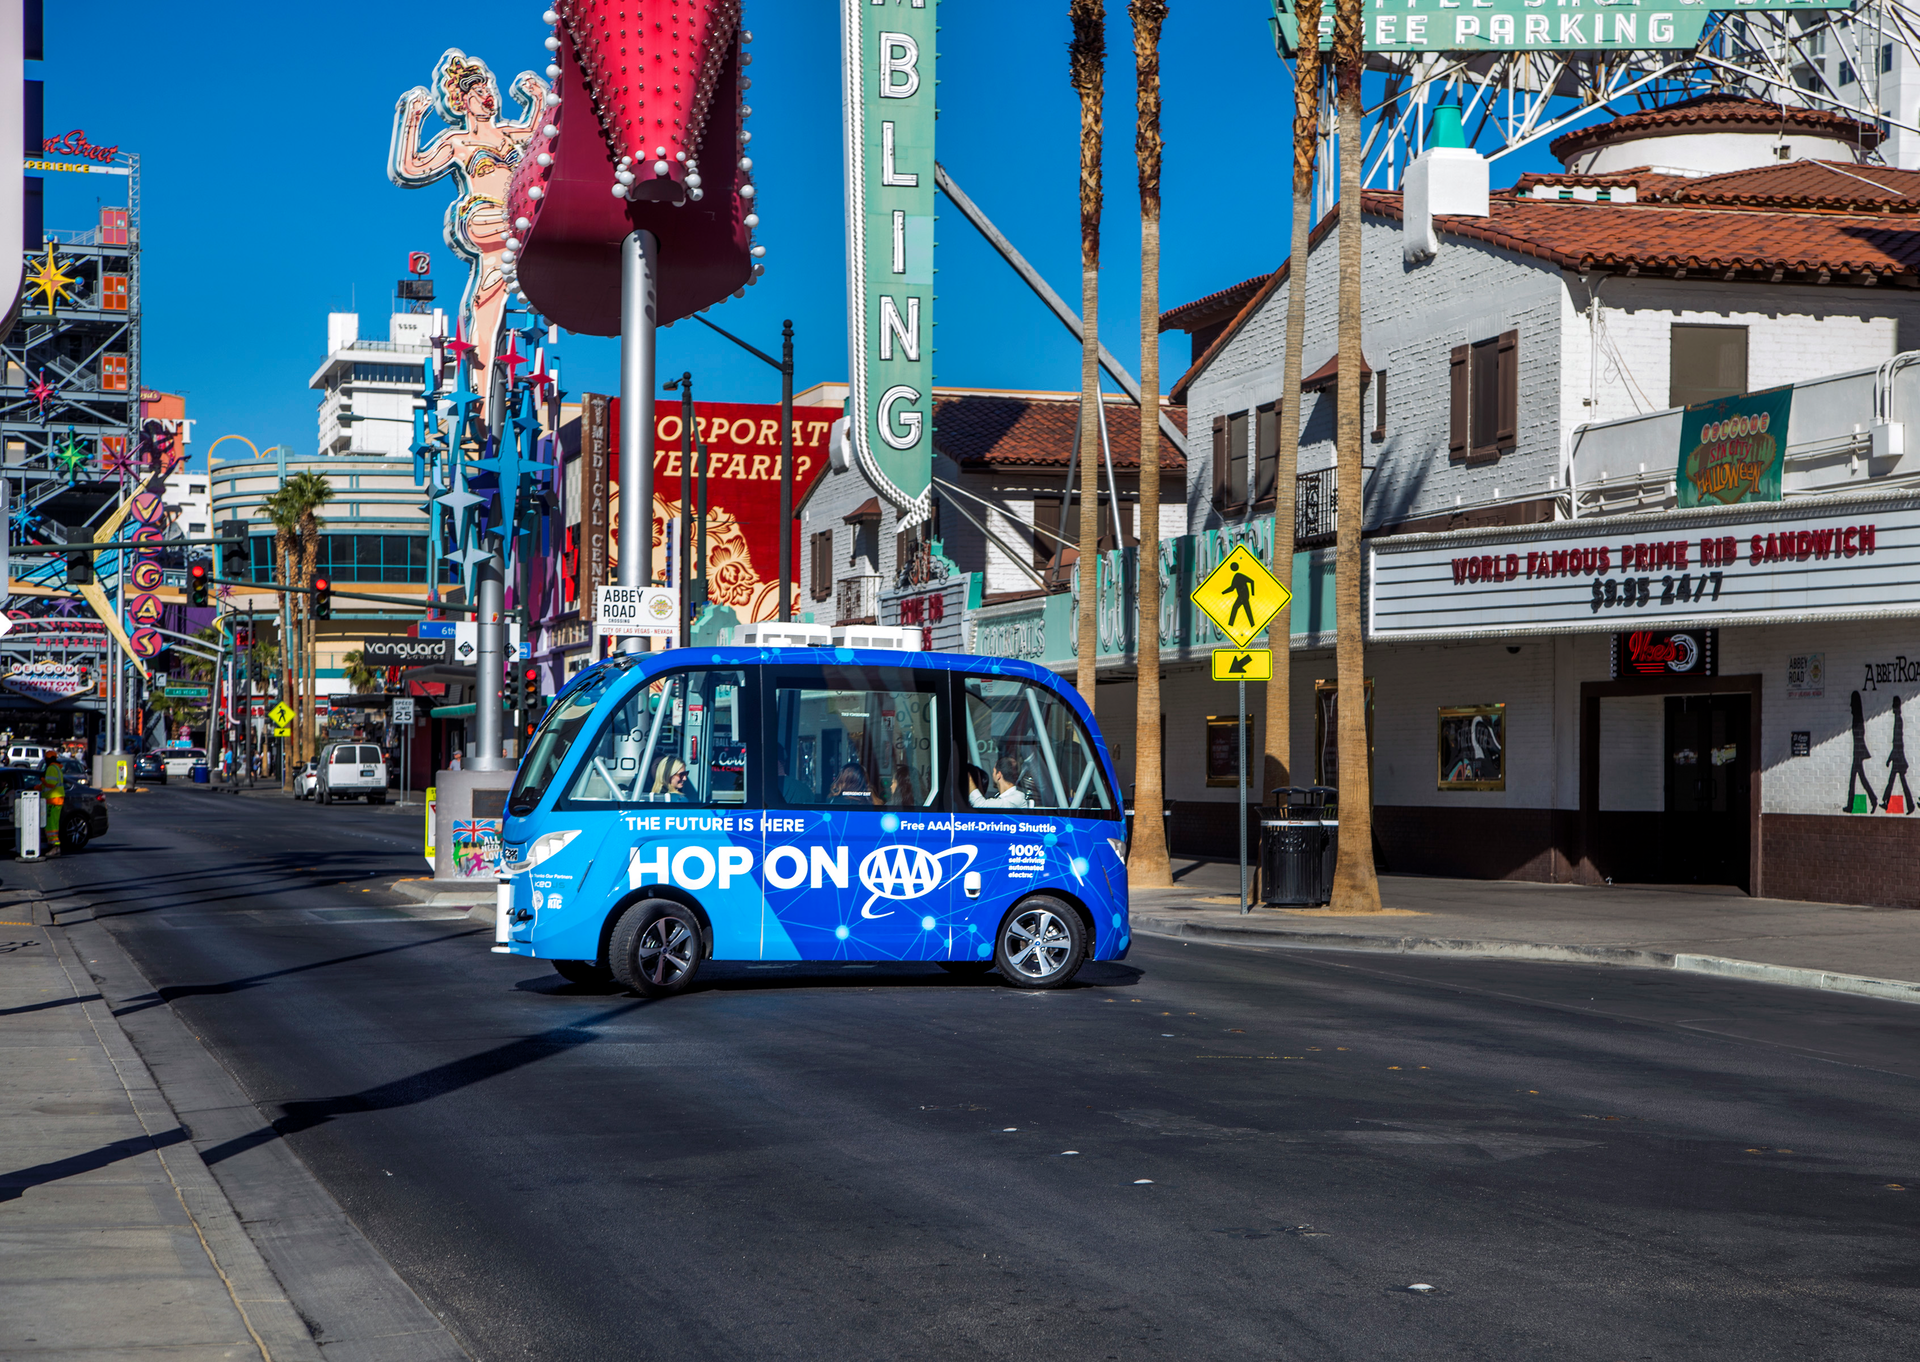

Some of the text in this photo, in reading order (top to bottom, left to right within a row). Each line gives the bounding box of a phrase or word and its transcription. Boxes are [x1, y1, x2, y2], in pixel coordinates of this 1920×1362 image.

[1455, 13, 1675, 45] PARKING
[60, 129, 118, 163] Street
[24, 160, 90, 173] PERIENCE
[872, 0, 925, 451] BLING
[653, 415, 829, 447] ORPORAT
[1701, 412, 1770, 443] WELCOME
[590, 426, 604, 527] MEDICAL
[1451, 524, 1876, 586] WORLD FAMOUS PRIME RIB SANDWICH
[133, 496, 161, 658] VEGAS
[604, 589, 644, 603] ABBEY
[1660, 571, 1723, 606] 24/7
[603, 604, 636, 618] ROAD
[365, 640, 446, 659] vanguard
[13, 664, 79, 673] WELCOM
[1789, 657, 1808, 669] ABBEY
[1788, 671, 1805, 683] ROAD
[395, 711, 412, 721] 25
[625, 816, 805, 832] THE FUTURE IS HERE
[900, 820, 1057, 834] Free AAA Self-Driving Shuttle
[481, 844, 500, 852] NEED
[483, 835, 500, 846] ALL
[1008, 844, 1045, 857] 100%
[628, 845, 849, 891] HOP ON
[1008, 857, 1046, 865] self-driving
[866, 847, 933, 897] AAA
